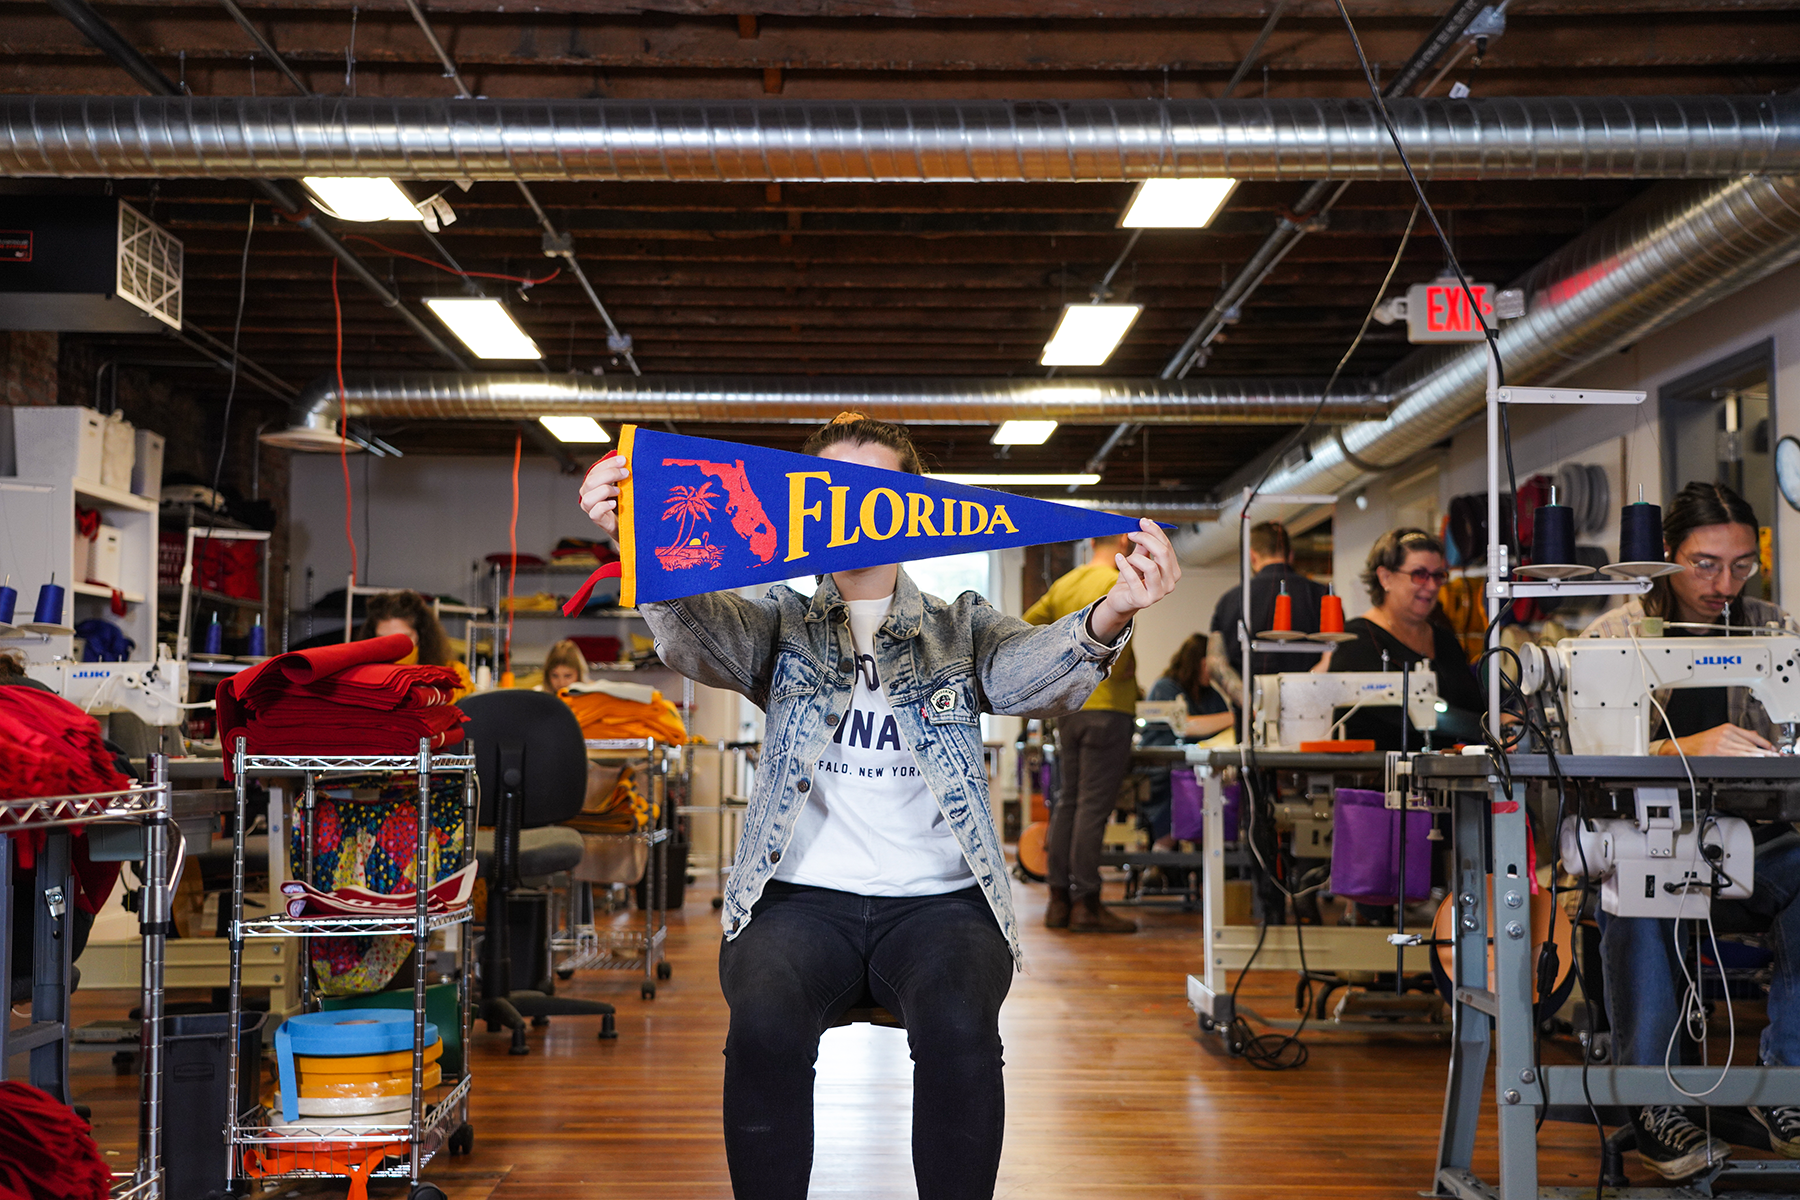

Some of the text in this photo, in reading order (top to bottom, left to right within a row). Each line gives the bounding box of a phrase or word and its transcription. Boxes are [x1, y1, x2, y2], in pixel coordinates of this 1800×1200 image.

[1426, 286, 1487, 332] EXIT
[783, 471, 1019, 562] FLORIDA
[1695, 655, 1742, 665] JUKI
[814, 760, 853, 775] FALO.
[859, 767, 884, 778] NEW
